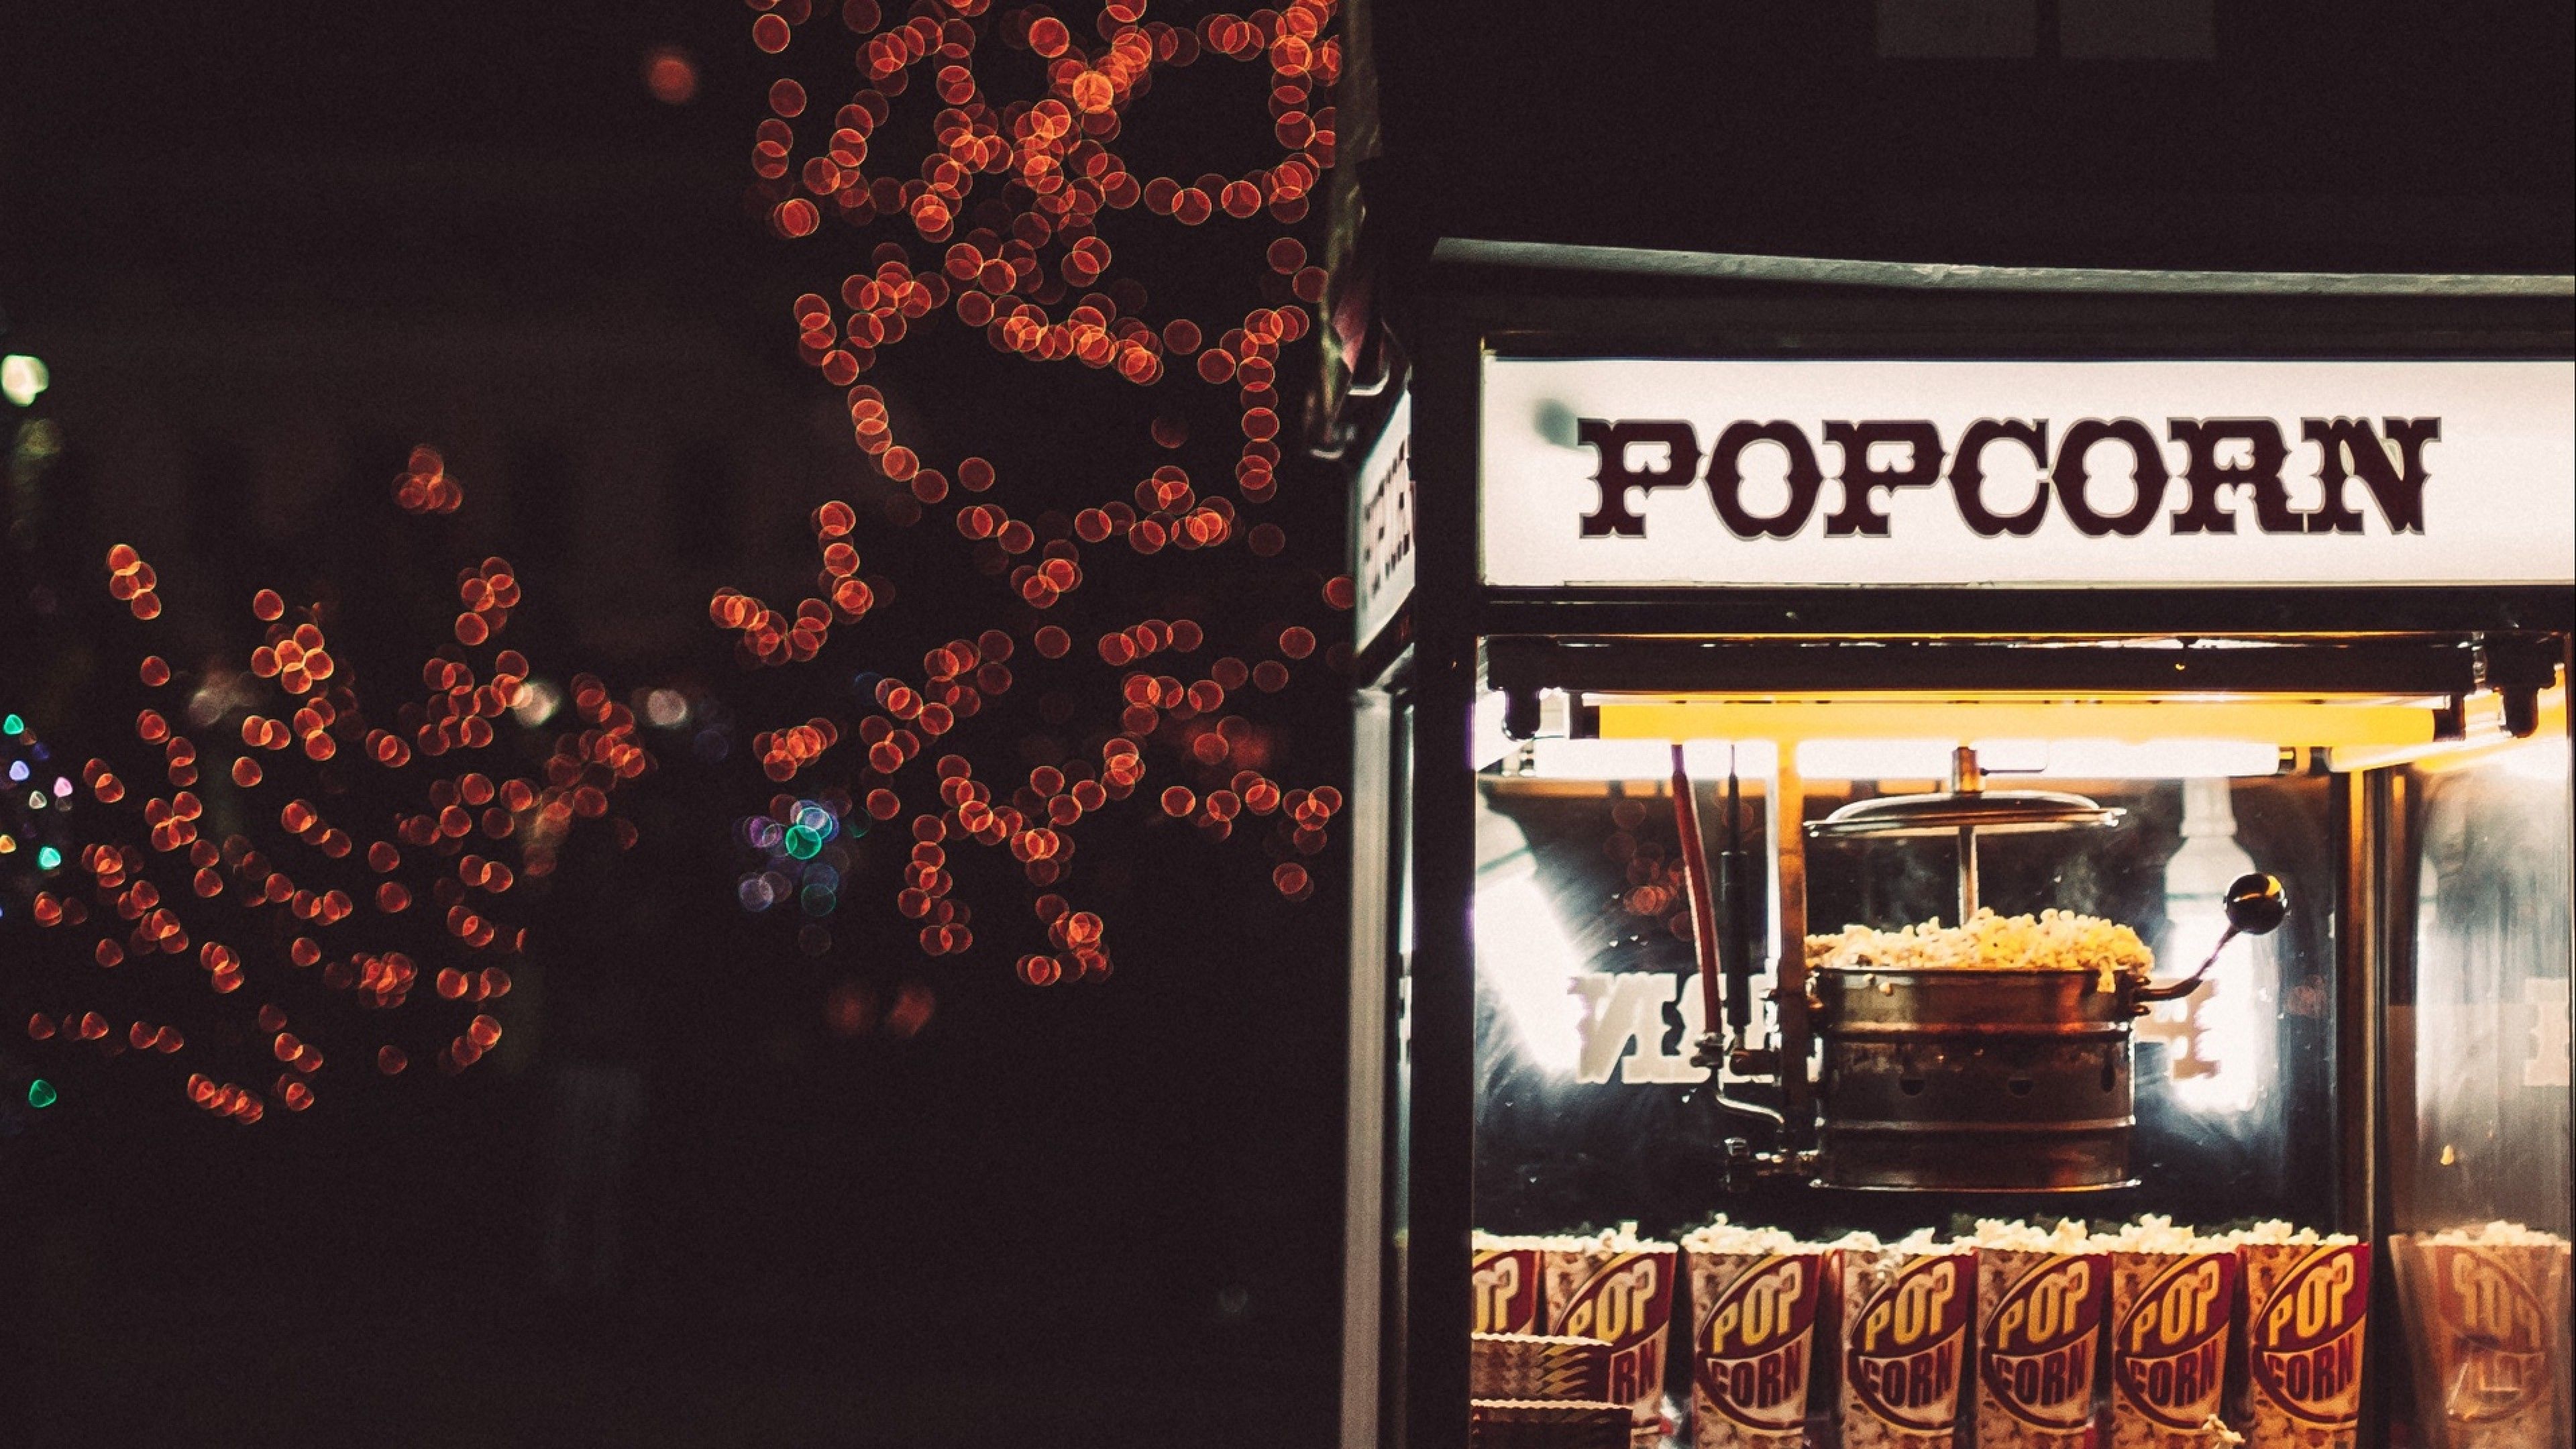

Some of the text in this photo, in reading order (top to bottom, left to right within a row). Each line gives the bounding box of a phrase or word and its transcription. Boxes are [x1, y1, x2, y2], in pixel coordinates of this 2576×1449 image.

[1578, 416, 2442, 541] POPCORN
[1472, 1256, 1519, 1333] OP
[1711, 1260, 1803, 1354] POP
[1865, 1260, 1955, 1352] POP
[1998, 1260, 2089, 1351] POP
[2133, 1260, 2219, 1353] POP
[2269, 1253, 2353, 1347] POP
[1613, 1338, 1656, 1405] RN
[1710, 1344, 1802, 1407] CORN
[1864, 1340, 1953, 1407] CORN
[1997, 1340, 2086, 1407] CORN
[2131, 1337, 2216, 1407] CORN
[2266, 1331, 2354, 1403] CORN
